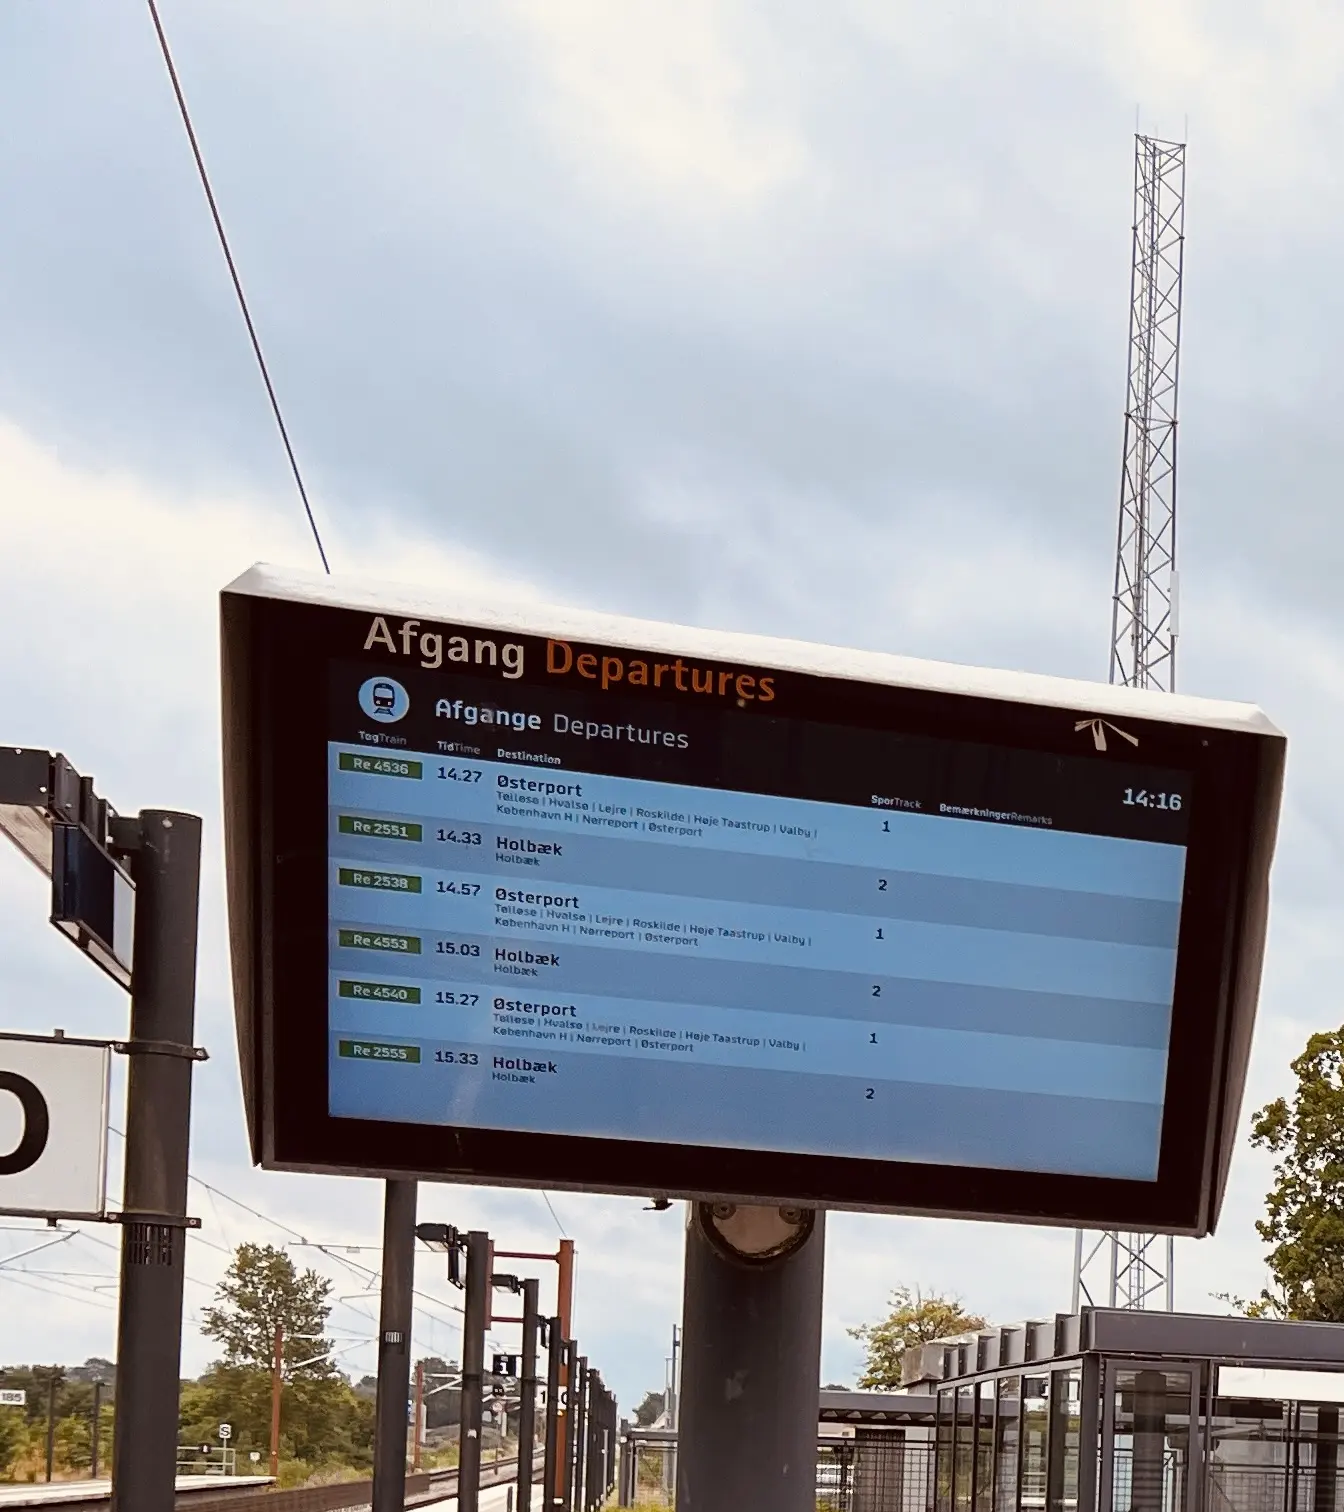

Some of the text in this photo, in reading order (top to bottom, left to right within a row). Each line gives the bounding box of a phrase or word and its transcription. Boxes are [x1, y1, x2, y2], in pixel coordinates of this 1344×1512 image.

[364, 616, 776, 702] Afgang Departures
[435, 699, 690, 749] Afgange Departures
[497, 748, 562, 765] Destination
[353, 757, 891, 833] Re 4536 14.27 Østerport 1
[1122, 787, 1182, 811] 14:16
[496, 804, 703, 838] København H Nørreport Østerport
[598, 802, 627, 818] Lejre
[636, 807, 685, 823] Roskilde
[694, 814, 720, 829] Høje
[721, 817, 770, 835] Taastrup
[779, 824, 811, 840] Valby
[353, 820, 888, 892] Re 2551 14.33 Holbæk 2
[495, 853, 540, 867] Holbæk
[353, 872, 371, 885] Re
[436, 880, 481, 897] 14.57
[495, 888, 580, 910] Østerport
[875, 928, 885, 940] 1
[495, 917, 699, 948] København H Nørreport Østerport
[595, 914, 624, 929] Lejre
[633, 918, 681, 933] Roskilde
[689, 924, 715, 939] Høje
[717, 927, 766, 943] Taastrup
[774, 933, 806, 948] Valby
[353, 935, 882, 998] Re 4553 15.03 Holbæk 2
[494, 963, 538, 978] Holbæk
[353, 985, 878, 1045] Re 4540 15.27 Østerport 1
[493, 1026, 694, 1053] København H Nørreport Østerport
[629, 1026, 677, 1040] Roskilde
[685, 1031, 710, 1045] Høje
[712, 1034, 760, 1049] Taastrup
[768, 1038, 800, 1053] Valby
[353, 1045, 875, 1100] Re 2555 15.33 Holbæk 2
[492, 1071, 536, 1085] Holbæk
[220, 1426, 230, 1437] S
